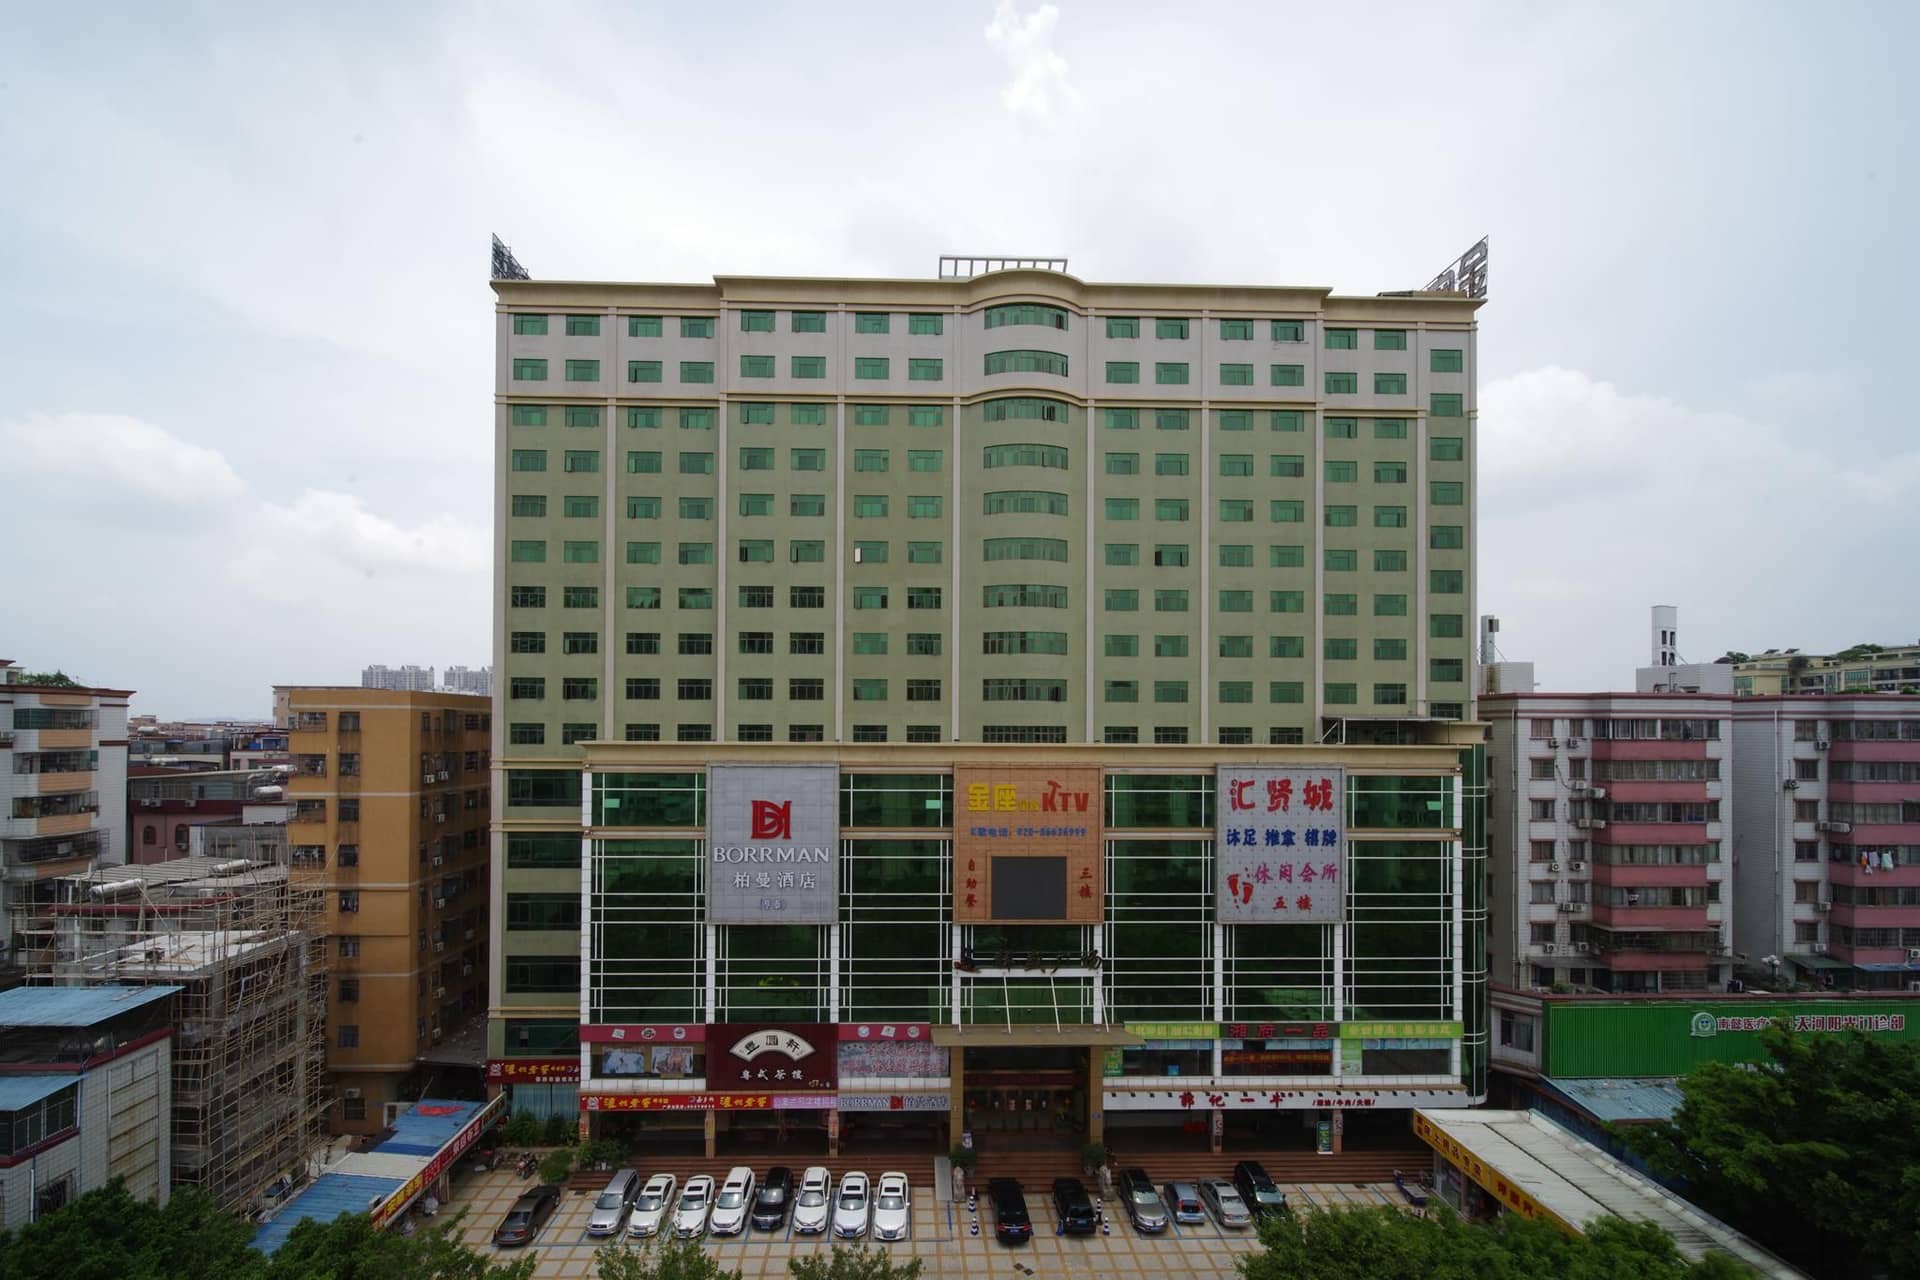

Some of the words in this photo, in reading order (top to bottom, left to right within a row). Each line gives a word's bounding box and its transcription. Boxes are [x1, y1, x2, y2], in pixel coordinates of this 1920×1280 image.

[967, 783, 1017, 812] 金座
[1042, 779, 1089, 812] KTV
[1229, 778, 1334, 812] 汇贤城
[713, 847, 829, 863] BORRMAN
[733, 871, 816, 889] 柏曼酒店
[1254, 862, 1338, 885] 休闲会所
